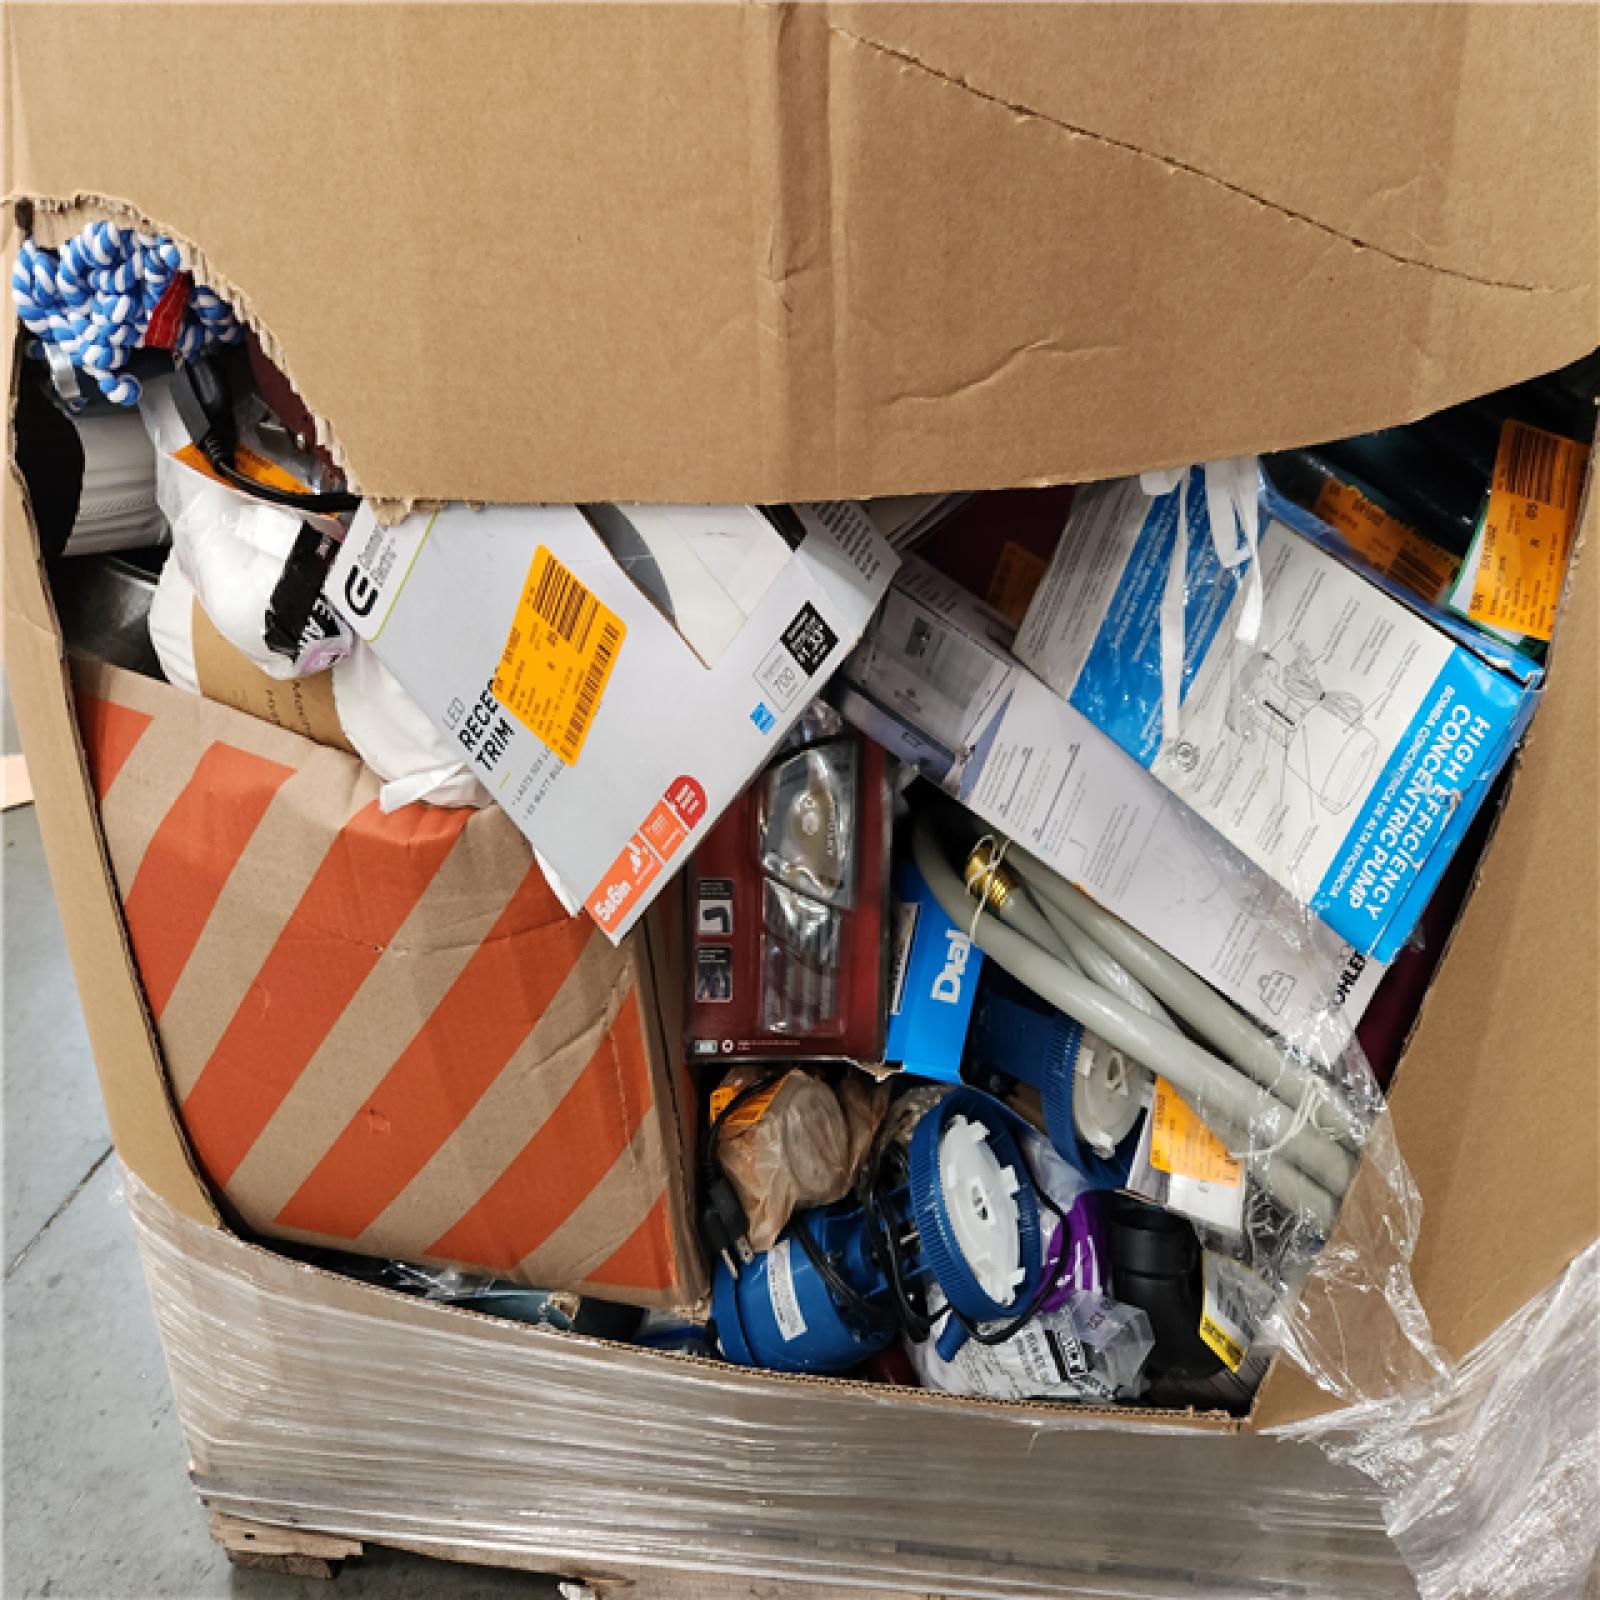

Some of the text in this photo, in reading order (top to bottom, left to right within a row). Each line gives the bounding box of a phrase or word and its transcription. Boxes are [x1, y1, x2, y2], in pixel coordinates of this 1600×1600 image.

[443, 697, 466, 730] LED
[458, 668, 499, 752] RECE
[475, 717, 516, 771] TRIM
[1379, 704, 1471, 848] CONCENTRIC
[1443, 715, 1491, 781] HIGH
[1349, 846, 1388, 909] PUMP
[1365, 784, 1448, 920] EFFICIENCY
